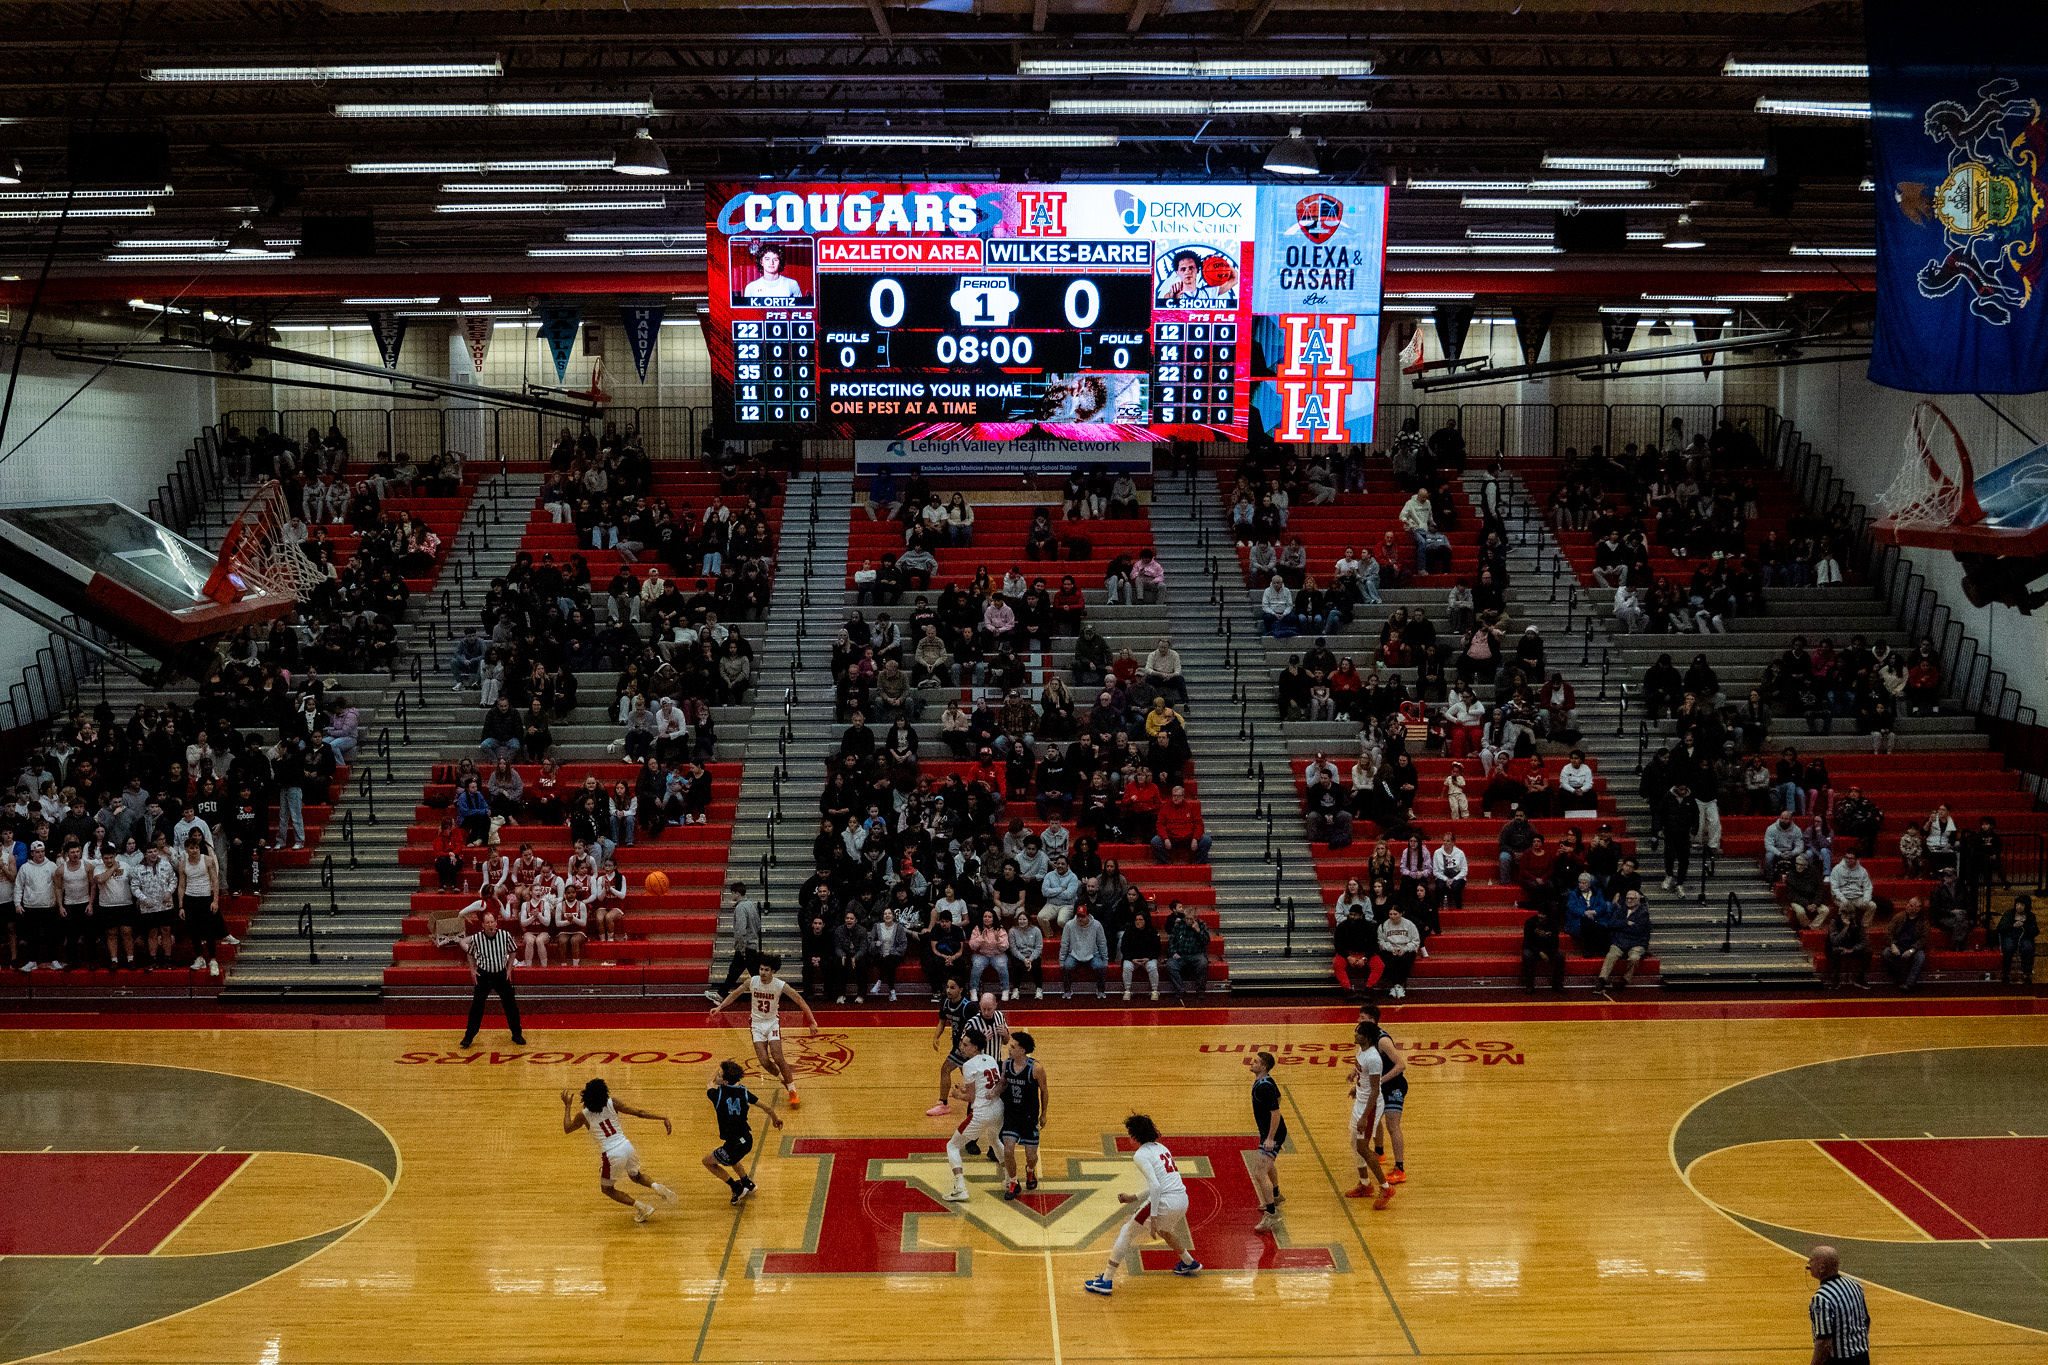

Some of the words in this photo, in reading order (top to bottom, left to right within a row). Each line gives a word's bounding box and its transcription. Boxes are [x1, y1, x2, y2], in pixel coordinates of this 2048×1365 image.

[744, 194, 977, 232] COUGARS
[1150, 202, 1243, 218] DERMDOX
[1151, 220, 1189, 234] Mohs
[1193, 220, 1241, 234] Center
[821, 244, 923, 261] HAZLETON
[928, 244, 979, 261] AREA
[990, 244, 1149, 263] WILKES-BARRE
[1286, 245, 1349, 269] OLEXA
[1353, 251, 1363, 265] &
[963, 280, 1007, 289] PERIOD
[1280, 269, 1354, 291] CASARI
[750, 297, 762, 307] K.
[764, 297, 796, 307] ORTIZ
[869, 278, 905, 328] 0
[1064, 279, 1100, 328] 0
[1165, 300, 1176, 309] C.
[1179, 299, 1227, 309] SHOVLIN
[1303, 293, 1328, 305] Ltd.
[974, 293, 995, 322] 1
[766, 312, 787, 320] PTS
[791, 312, 812, 320] FLS
[1189, 314, 1210, 322] PTS
[1214, 314, 1235, 322] FLS
[738, 324, 759, 338] 22
[773, 325, 781, 337] 0
[799, 325, 807, 337] 0
[1161, 326, 1179, 340] 12
[1195, 327, 1203, 339] 0
[1220, 327, 1229, 339] 0
[635, 309, 650, 377] HANOVER
[826, 334, 869, 343] FOULS
[1100, 335, 1143, 344] FOULS
[738, 345, 759, 359] 23
[773, 346, 781, 358] 0
[799, 346, 807, 358] 0
[840, 347, 856, 367] 0
[936, 336, 1033, 364] 08:00
[1160, 347, 1178, 360] 14
[1194, 347, 1202, 360] 0
[1220, 347, 1228, 360] 0
[1113, 348, 1129, 368] 0
[738, 365, 760, 379] 35
[774, 366, 782, 379] 0
[799, 366, 807, 379] 0
[1158, 367, 1180, 381] 22
[1194, 368, 1202, 380] 0
[1219, 368, 1227, 380] 0
[742, 386, 757, 400] 11
[774, 387, 783, 399] 0
[800, 387, 808, 399] 0
[830, 384, 926, 398] PROTECTING
[930, 384, 972, 398] YOUR
[975, 384, 1022, 398] HOME
[1163, 388, 1174, 402] 2
[1193, 389, 1201, 401] 0
[1219, 389, 1227, 401] 0
[741, 406, 760, 420] 12
[775, 407, 783, 420] 0
[800, 407, 809, 420] 0
[830, 402, 864, 415] ONE
[868, 402, 902, 415] PEST
[904, 402, 923, 415] AT
[926, 402, 938, 415] A
[941, 402, 977, 415] TIME
[1163, 408, 1174, 422] 5
[1192, 409, 1201, 421] 0
[1218, 409, 1226, 421] 0
[911, 440, 959, 454] Lehigh
[961, 440, 1005, 454] Valley
[1008, 440, 1055, 453] Health
[1058, 440, 1120, 453] Network
[198, 801, 217, 813] PSU
[753, 991, 775, 1000] COUGARS
[757, 1000, 770, 1013] 23
[393, 1050, 713, 1065] COUGARS
[599, 1118, 616, 1137] 11
